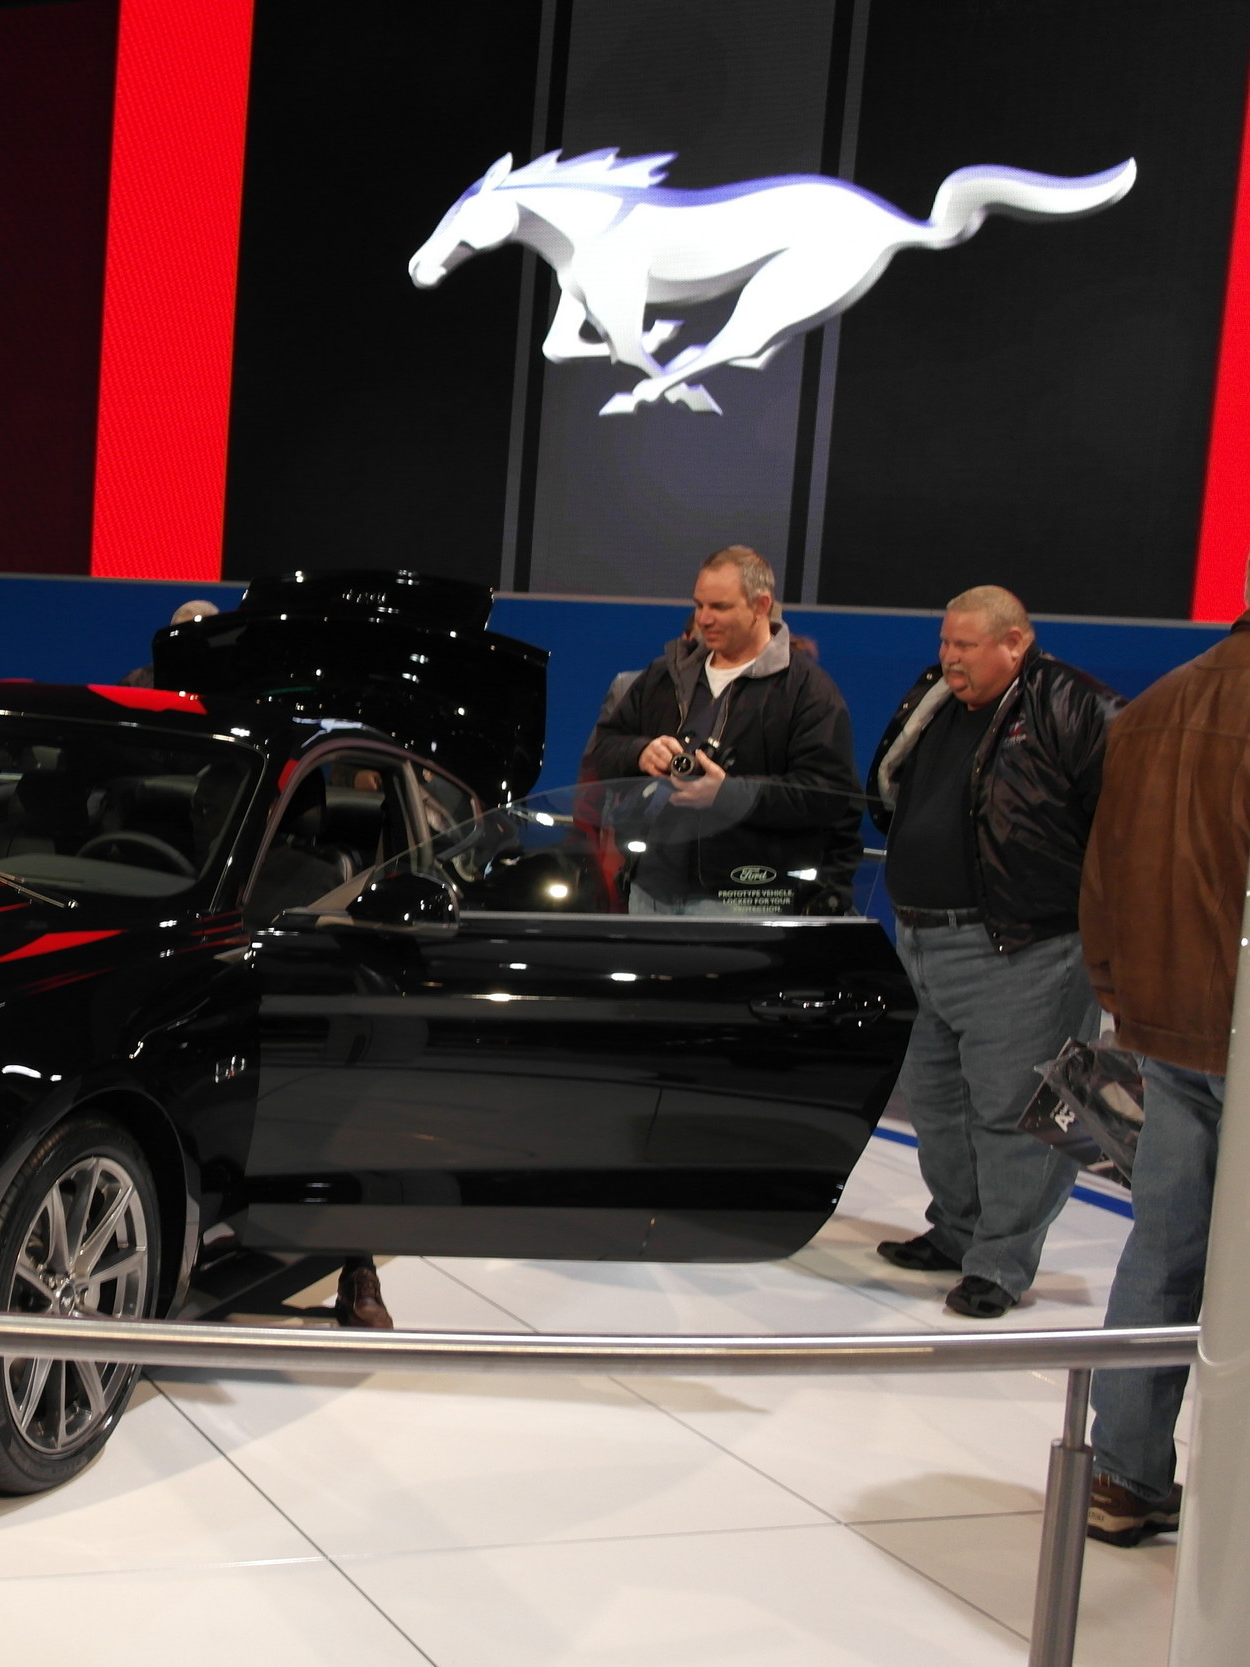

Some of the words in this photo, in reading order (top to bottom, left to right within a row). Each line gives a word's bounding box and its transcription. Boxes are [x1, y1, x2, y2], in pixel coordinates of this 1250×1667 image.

[739, 867, 767, 881] Ford
[718, 889, 761, 898] PROTOTYPE
[754, 897, 769, 905] FOR
[770, 897, 791, 905] YOUR
